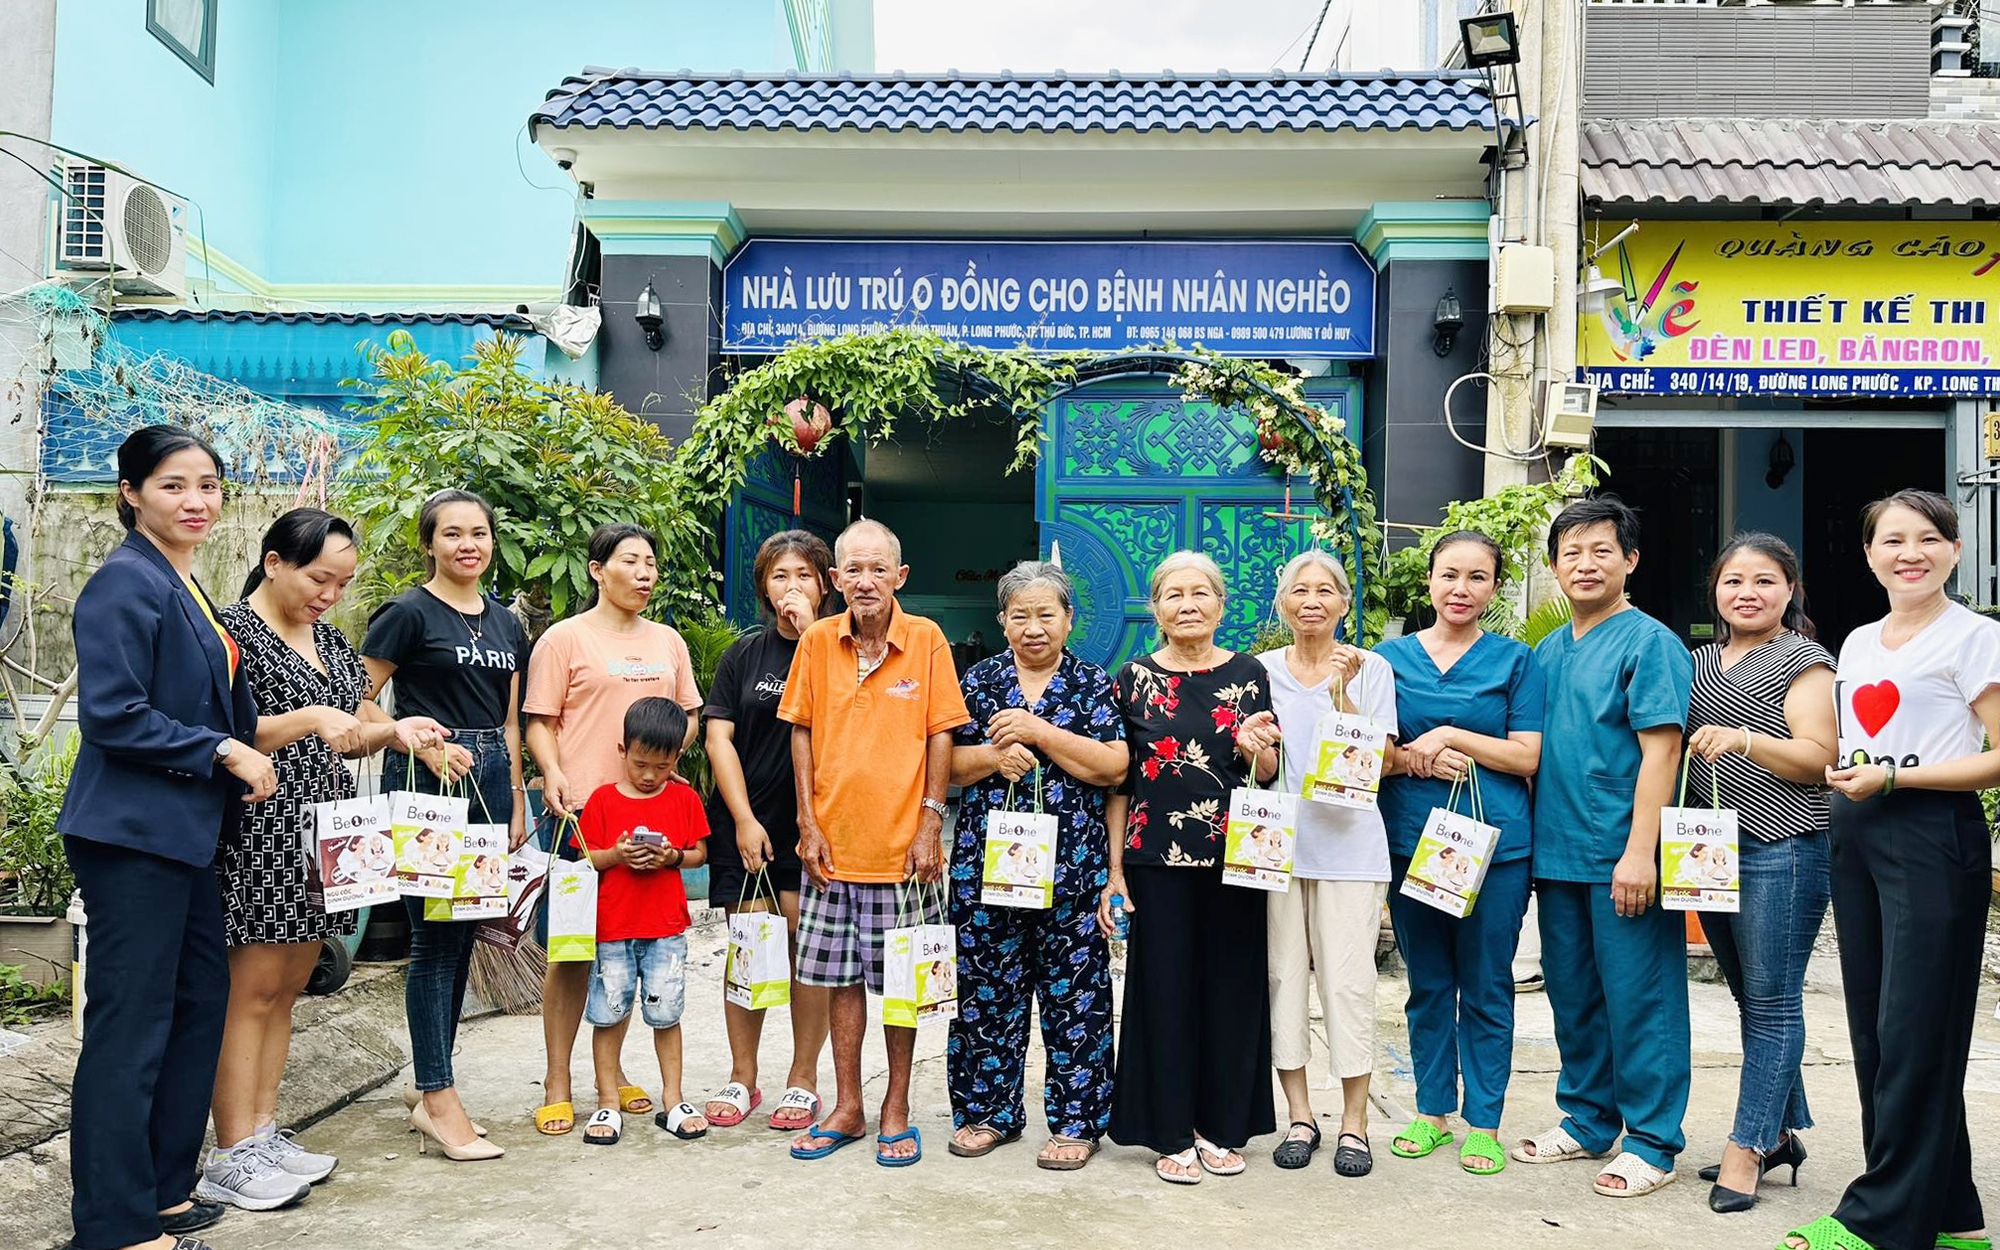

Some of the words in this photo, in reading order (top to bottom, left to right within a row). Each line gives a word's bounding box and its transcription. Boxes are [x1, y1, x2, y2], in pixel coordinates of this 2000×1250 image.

[742, 266, 798, 310] NHÀ
[806, 272, 850, 311] LƯU
[859, 267, 903, 311] TRÚ
[940, 259, 1020, 312] ĐỒNG
[1028, 278, 1089, 313] CHO
[1097, 268, 1163, 322] BỆNH
[1172, 269, 1247, 313] NHÂN
[1256, 269, 1351, 314] NGHÈO
[1742, 294, 1848, 324] THIẾT
[1863, 294, 1915, 324] KẾ
[1929, 301, 1986, 324] THI
[971, 324, 992, 338] LONG
[1092, 326, 1111, 339] HCM
[1140, 326, 1159, 339] 0965
[1162, 326, 1176, 340] 146
[1207, 327, 1224, 340] NGA
[1252, 327, 1267, 340] 500
[1269, 327, 1284, 340] 479
[1334, 327, 1351, 341] HUY
[1689, 334, 1751, 361] ĐÈN
[1763, 339, 1826, 365] LED,
[1839, 335, 1990, 365] BĂNGRON,
[1620, 368, 1655, 390] CHỈ:
[1759, 372, 1807, 390] ĐƯỜNG
[1811, 375, 1847, 390] LONG
[1914, 375, 1937, 391] KP.
[1942, 375, 1978, 391] LONG
[455, 640, 516, 671] PARIS
